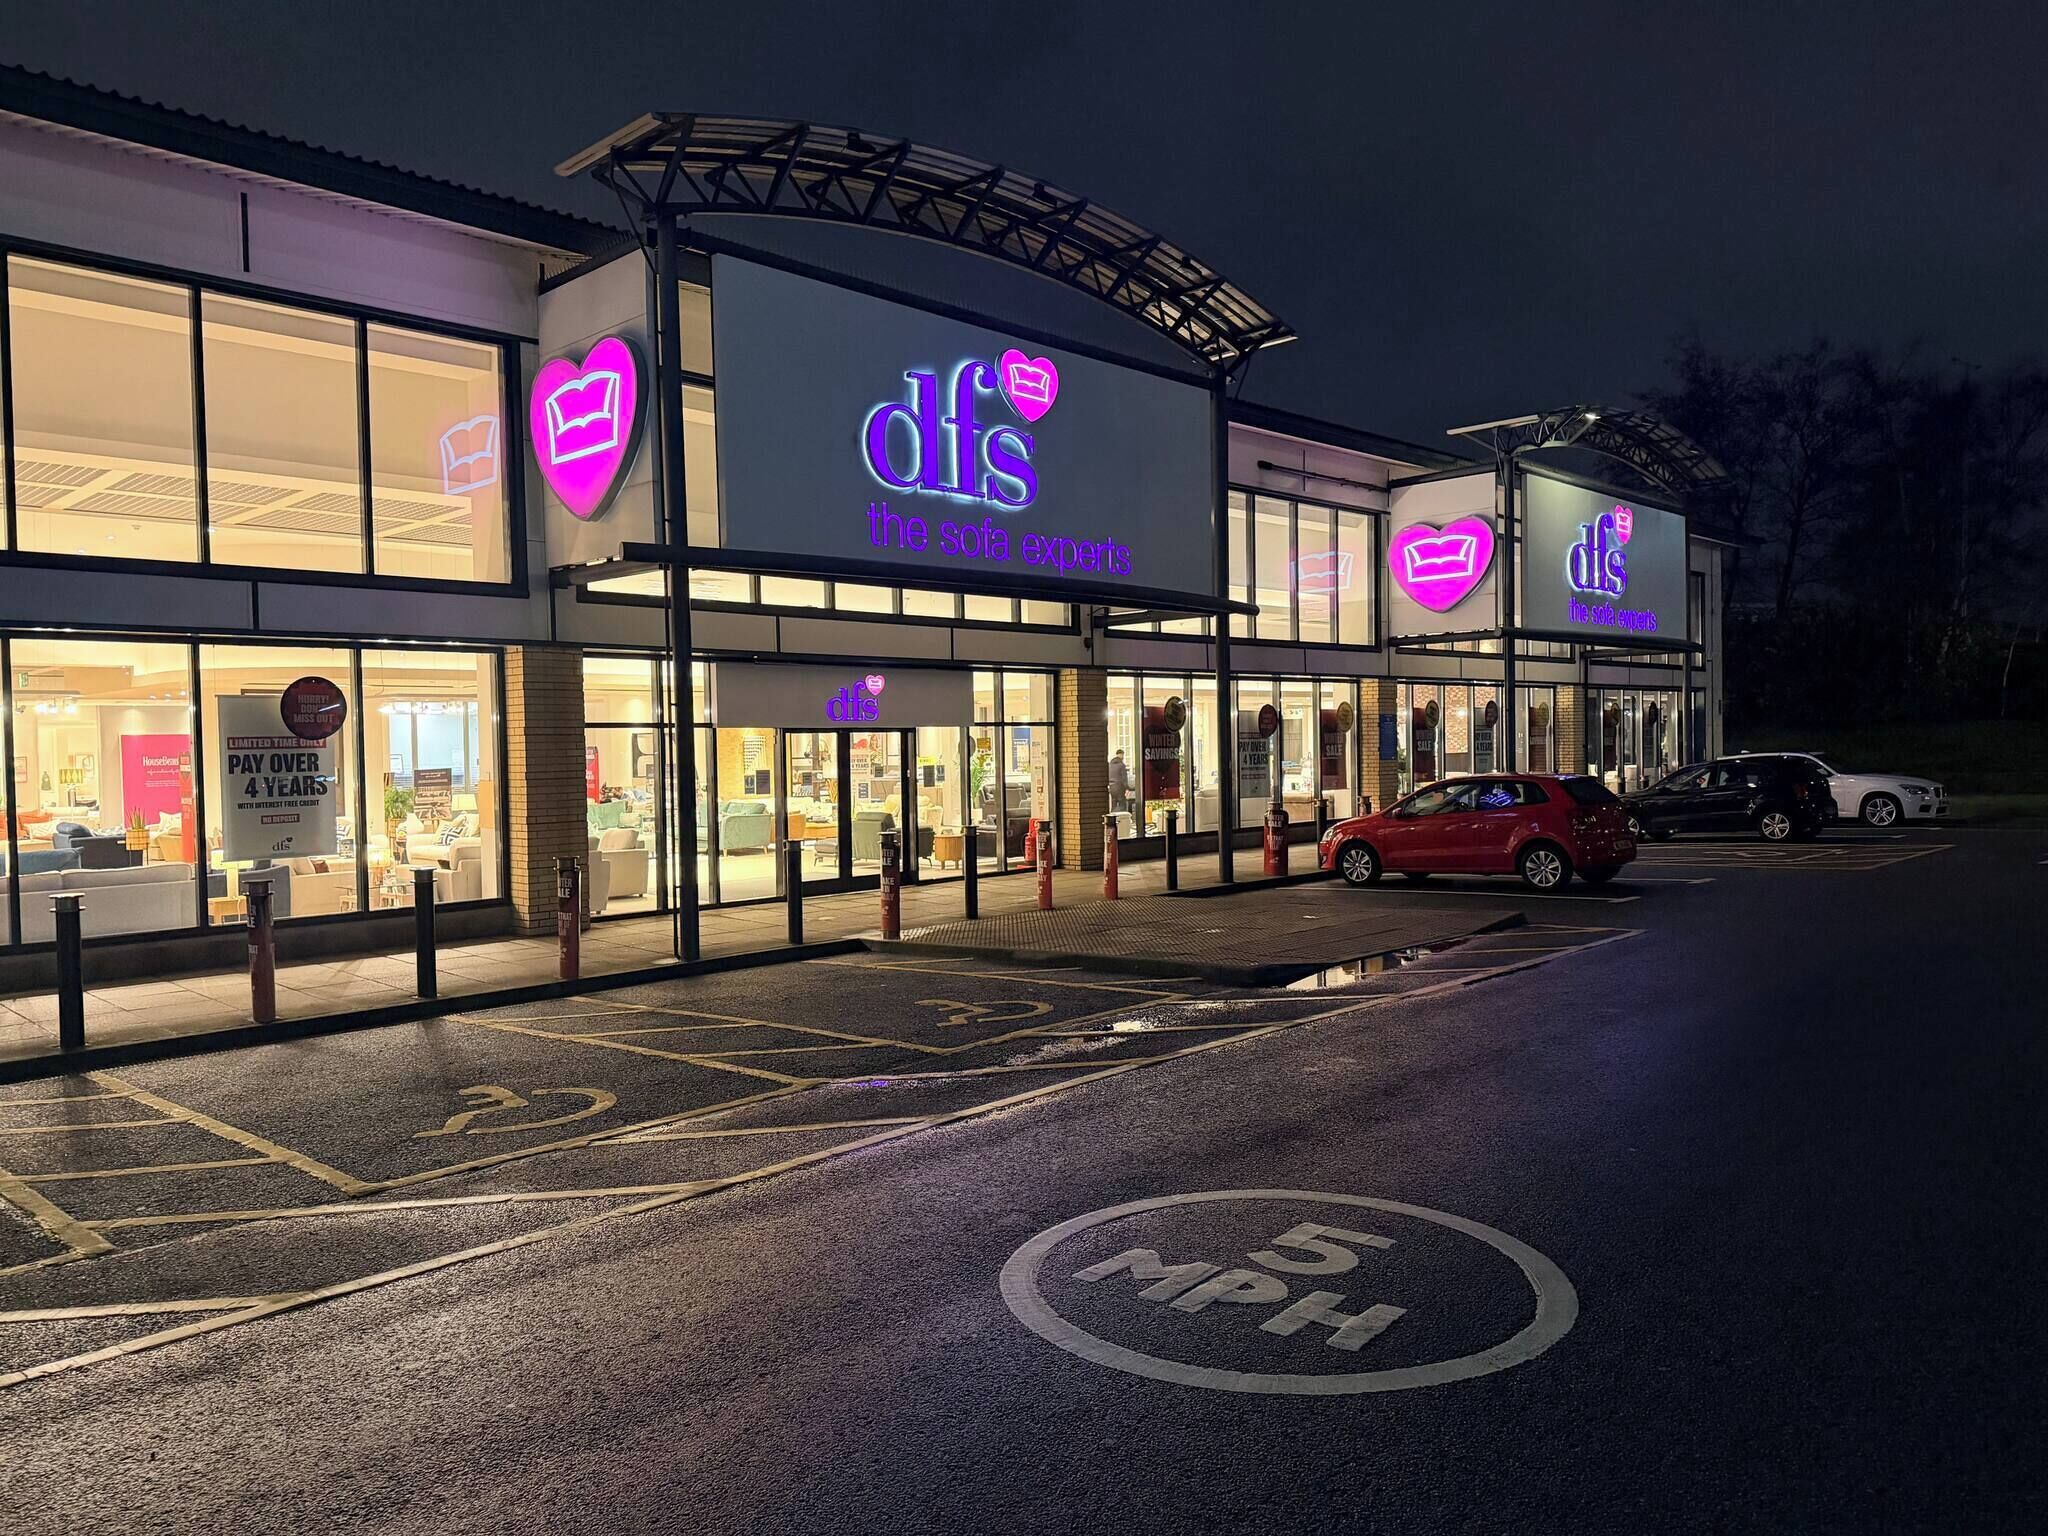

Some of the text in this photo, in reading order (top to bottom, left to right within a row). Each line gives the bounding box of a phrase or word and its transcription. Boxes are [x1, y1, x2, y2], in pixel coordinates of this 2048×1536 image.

[865, 361, 1038, 507] dfs
[867, 502, 1133, 576] the sofa experts
[1567, 513, 1628, 597] dfs
[1568, 596, 1657, 634] the sofa experts
[827, 681, 880, 721] dfs
[293, 713, 335, 723] MISS OUT
[229, 738, 271, 748] LIMITED
[273, 738, 299, 747] TIME
[1144, 748, 1180, 760] SAVINGS
[1325, 745, 1343, 756] SALE
[1417, 741, 1432, 751] SALE
[228, 752, 320, 775] PAY OVER
[244, 775, 329, 798] 4 YEARS
[237, 799, 320, 810] WITH INTEREST FREE CREDIT
[272, 839, 291, 851] dfs
[1246, 1222, 1397, 1275] 5
[1071, 1248, 1408, 1352] MPH
